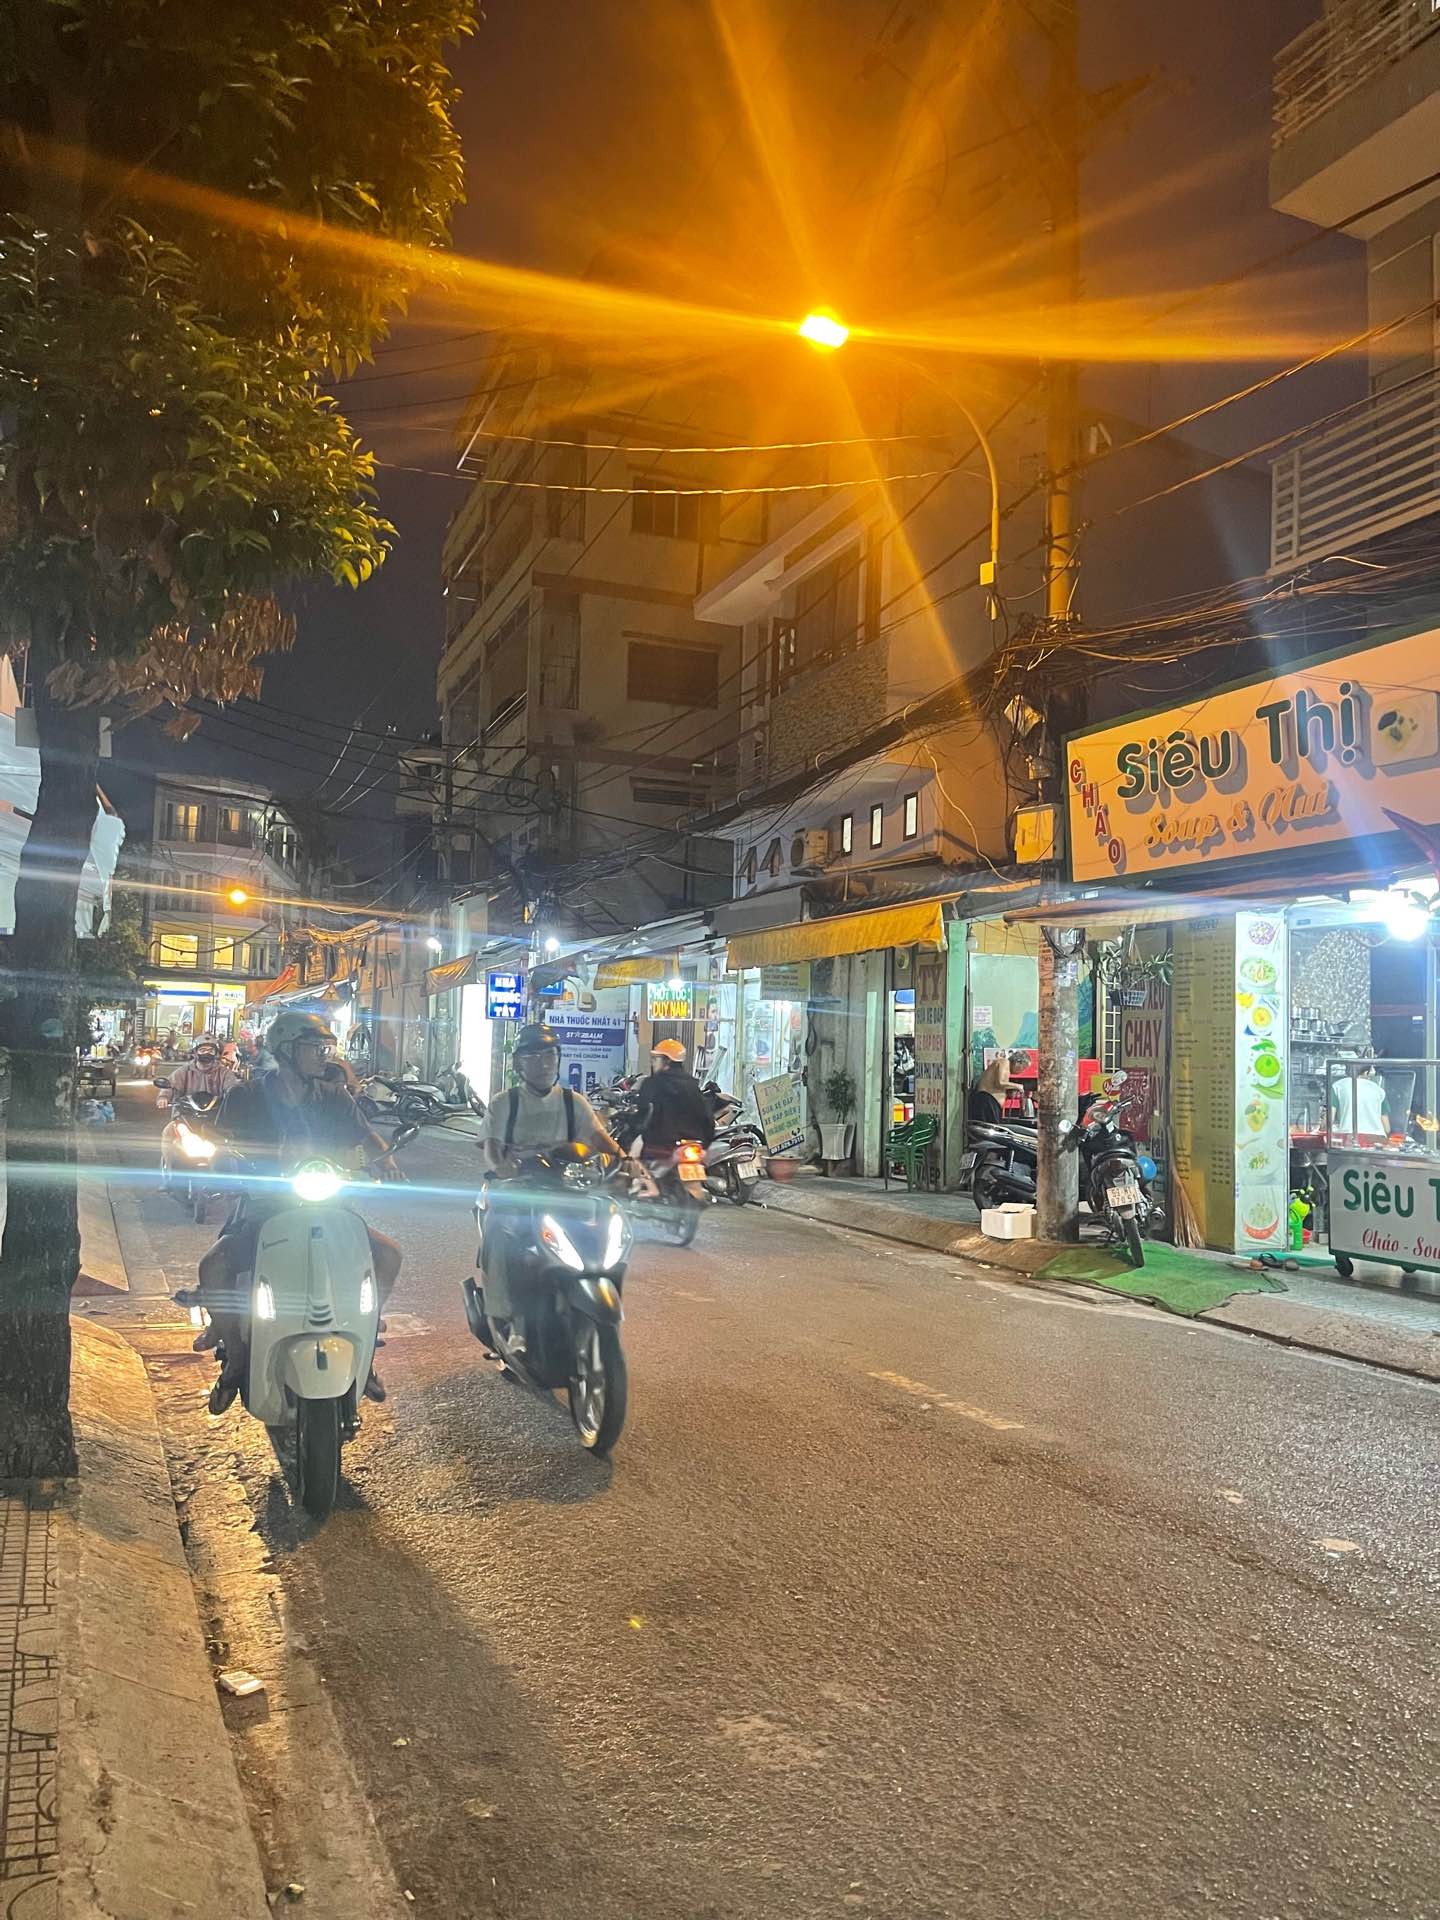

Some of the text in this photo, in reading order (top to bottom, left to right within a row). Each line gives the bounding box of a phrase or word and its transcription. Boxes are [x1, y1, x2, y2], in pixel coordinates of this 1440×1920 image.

[1116, 681, 1357, 799] Siêu Thị
[1070, 759, 1121, 864] CHÁO
[1144, 812, 1219, 848] Soup
[1259, 781, 1333, 830] Nui
[494, 1003, 517, 1017] TÂY
[1124, 1019, 1163, 1058] CHAY
[1343, 1169, 1414, 1218] Siêu
[1362, 1228, 1399, 1253] Cháo
